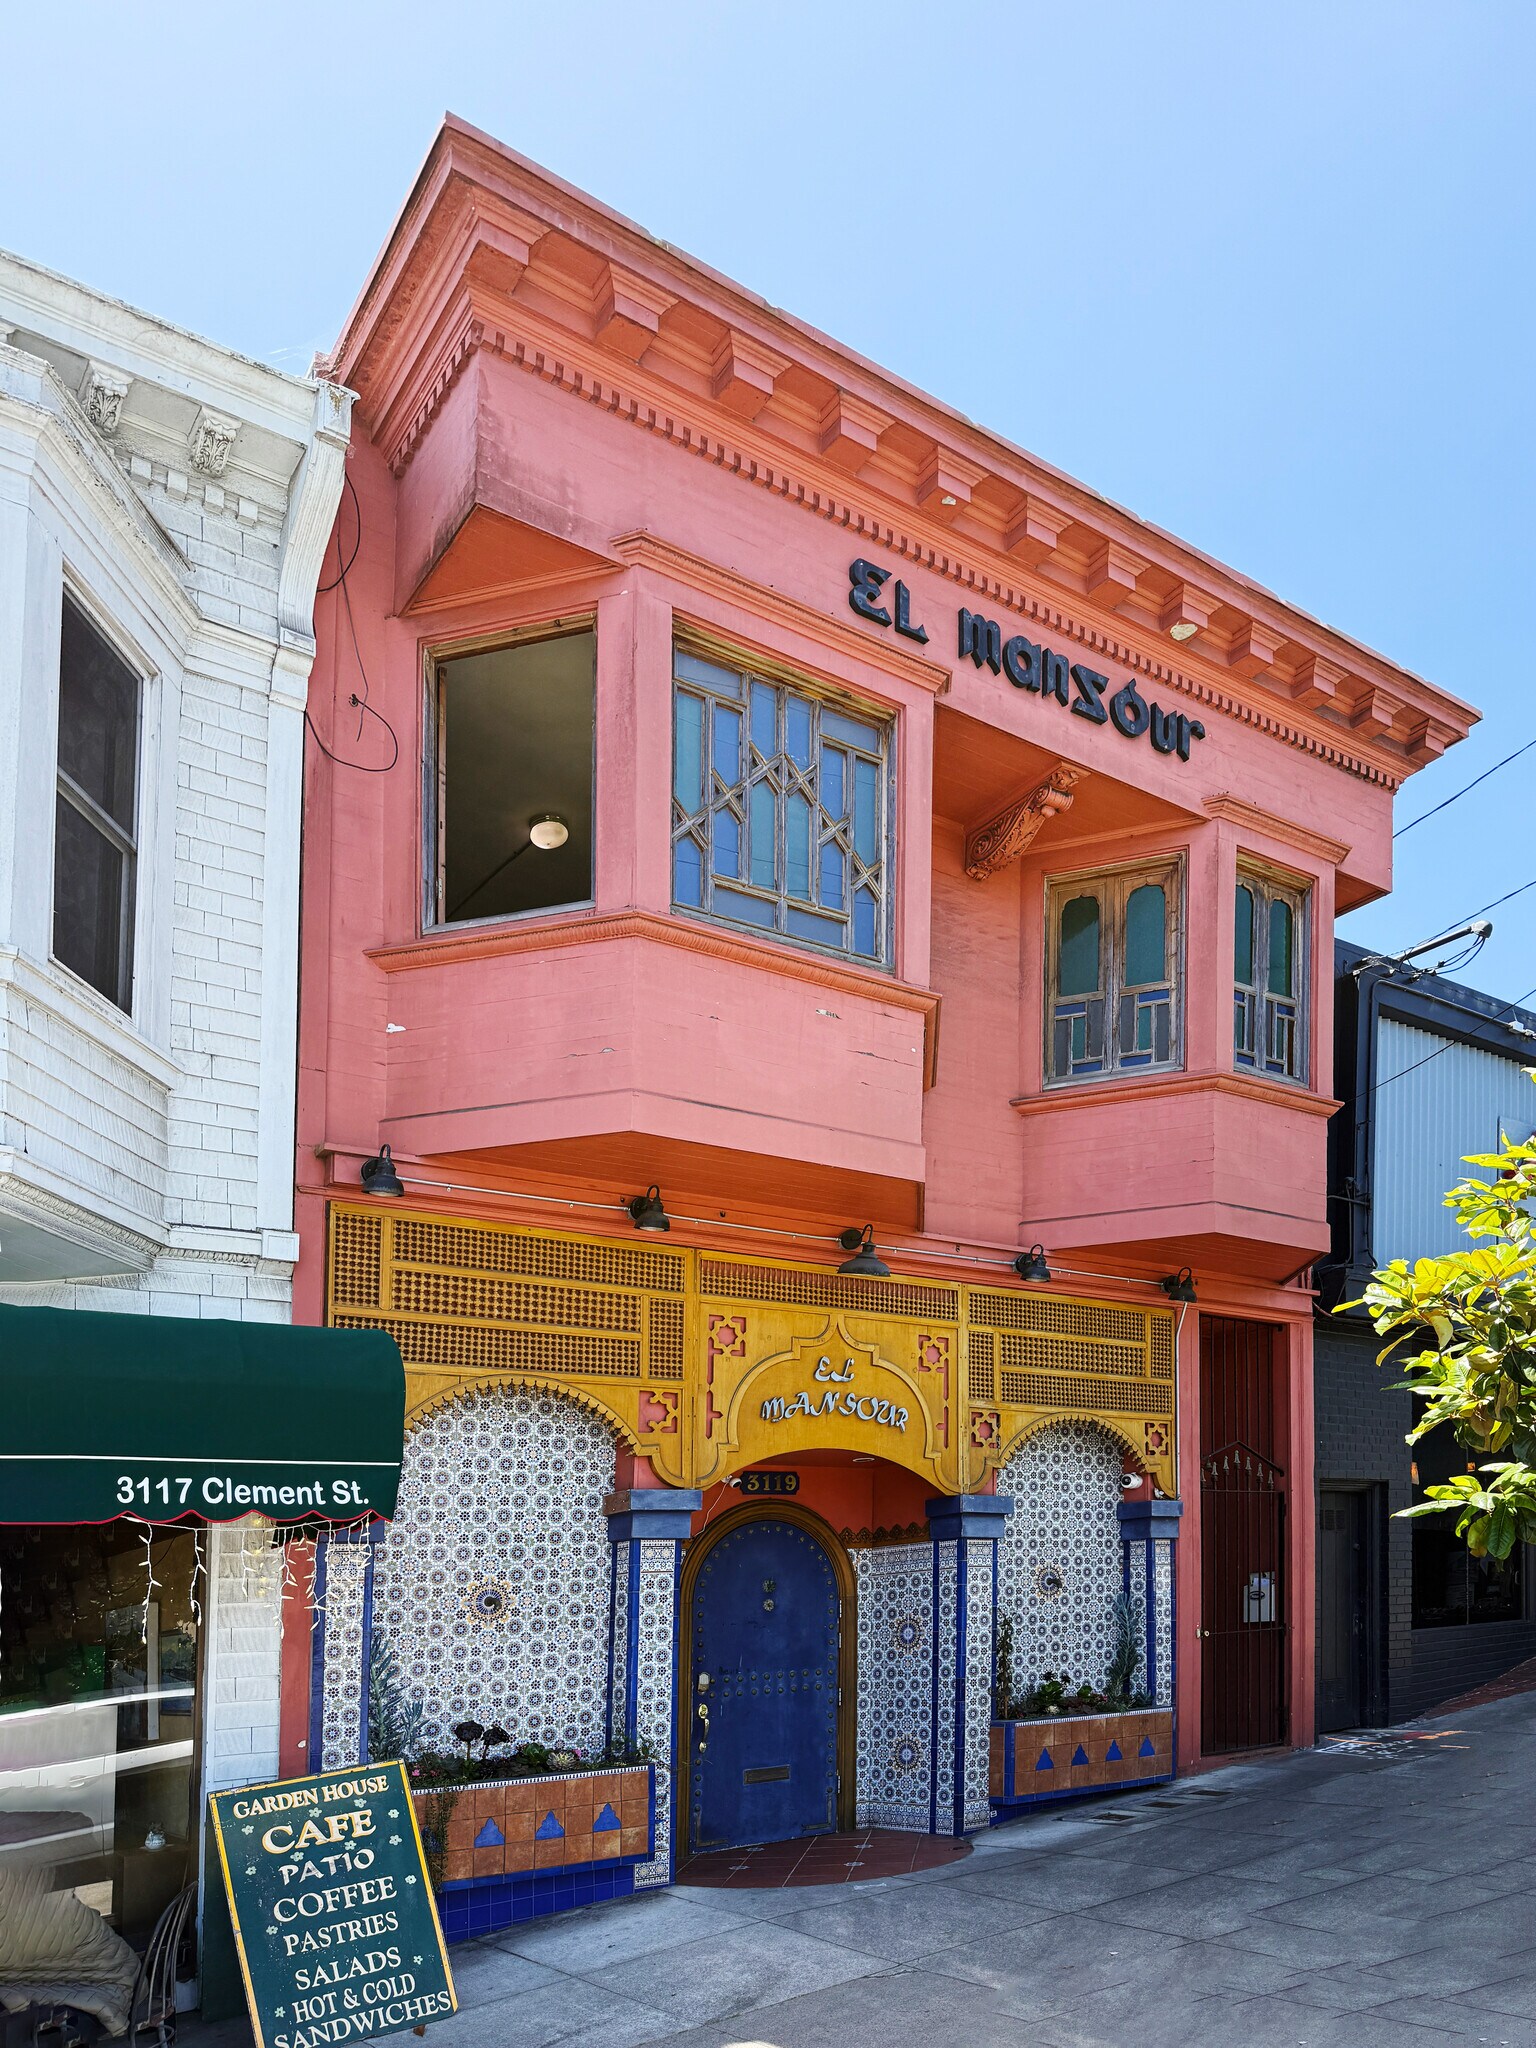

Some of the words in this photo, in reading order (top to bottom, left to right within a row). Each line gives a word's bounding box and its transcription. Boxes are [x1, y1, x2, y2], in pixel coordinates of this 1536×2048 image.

[848, 557, 930, 645] EL
[814, 1356, 855, 1382] EL
[761, 1391, 909, 1432] MANSOUR
[116, 1476, 194, 1504] 3117
[201, 1476, 327, 1505] Clement
[332, 1479, 370, 1505] St.
[746, 1475, 797, 1491] 3119
[233, 1791, 319, 1819] GARDEN
[323, 1775, 389, 1802] HOUSE
[261, 1808, 377, 1855] CAFE
[278, 1848, 376, 1886] PATIO
[273, 1875, 398, 1923] COFFEE
[283, 1911, 399, 1957] PASTRIES
[294, 1946, 402, 1991] SALADS
[274, 1991, 451, 2048] SANDWICHES
[292, 1991, 338, 2024] HOT
[343, 1988, 361, 2010] &
[362, 1973, 416, 2005] COLD
